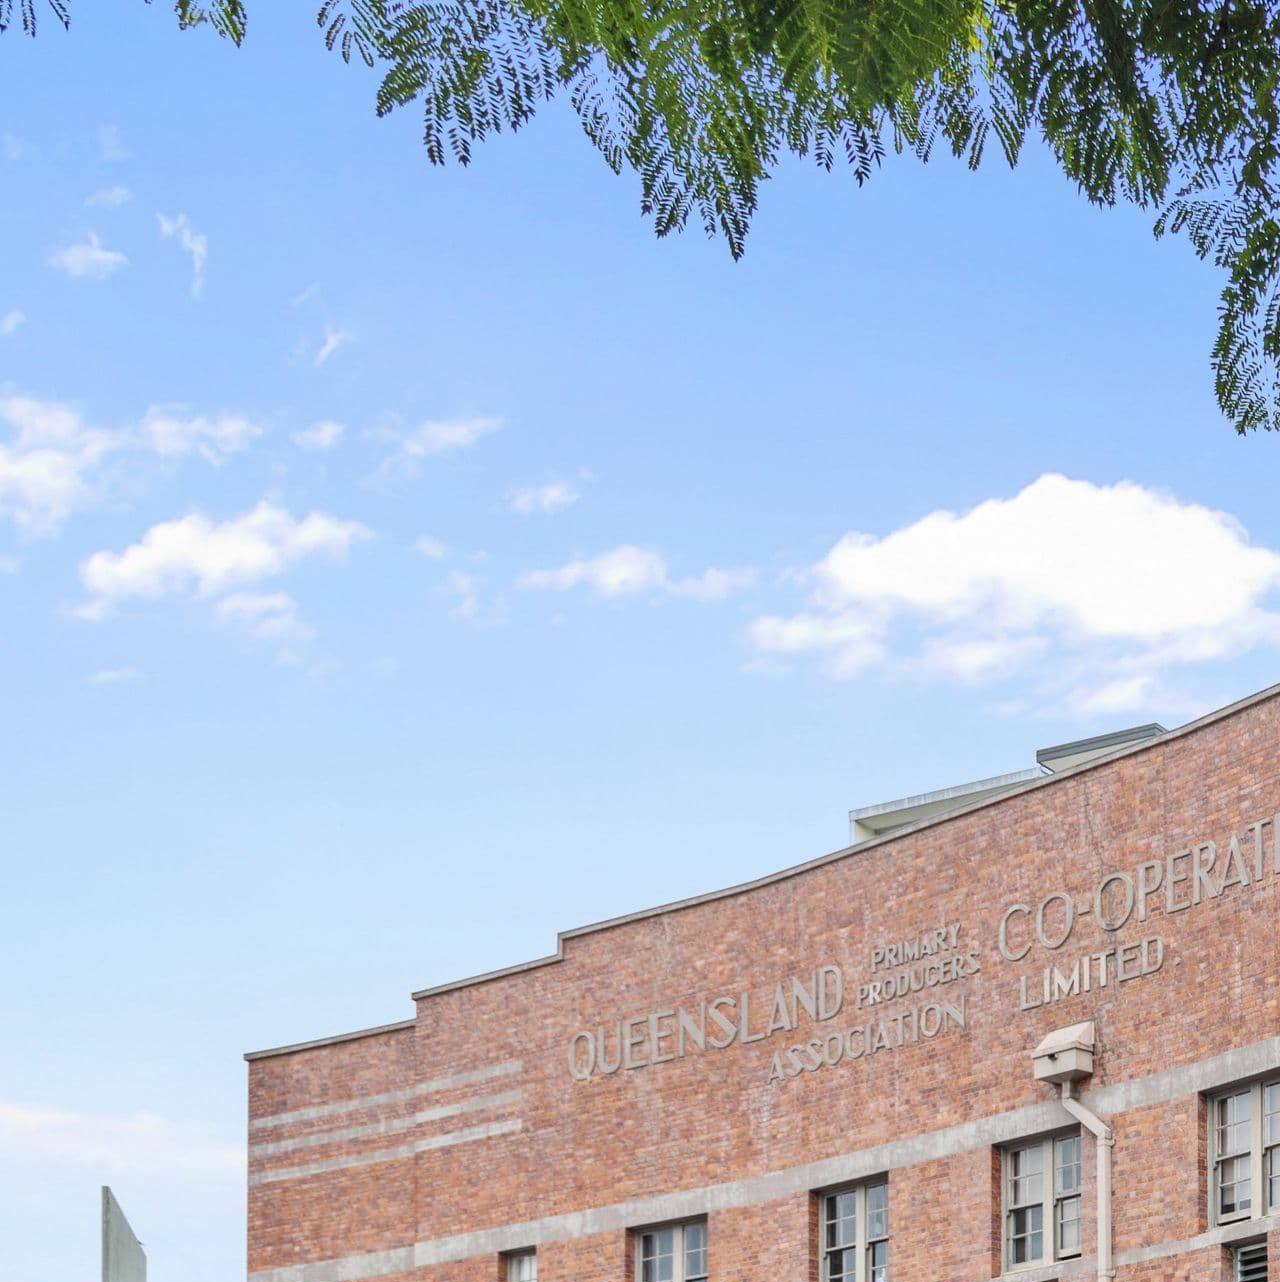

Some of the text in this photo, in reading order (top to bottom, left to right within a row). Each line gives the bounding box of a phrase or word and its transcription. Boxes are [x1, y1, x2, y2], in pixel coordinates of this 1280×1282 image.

[855, 953, 980, 1009] PRODUCERS
[872, 923, 962, 972] PRIMARY
[567, 964, 843, 1082] QUEENSLAND
[766, 995, 967, 1085] ASSOCIATION
